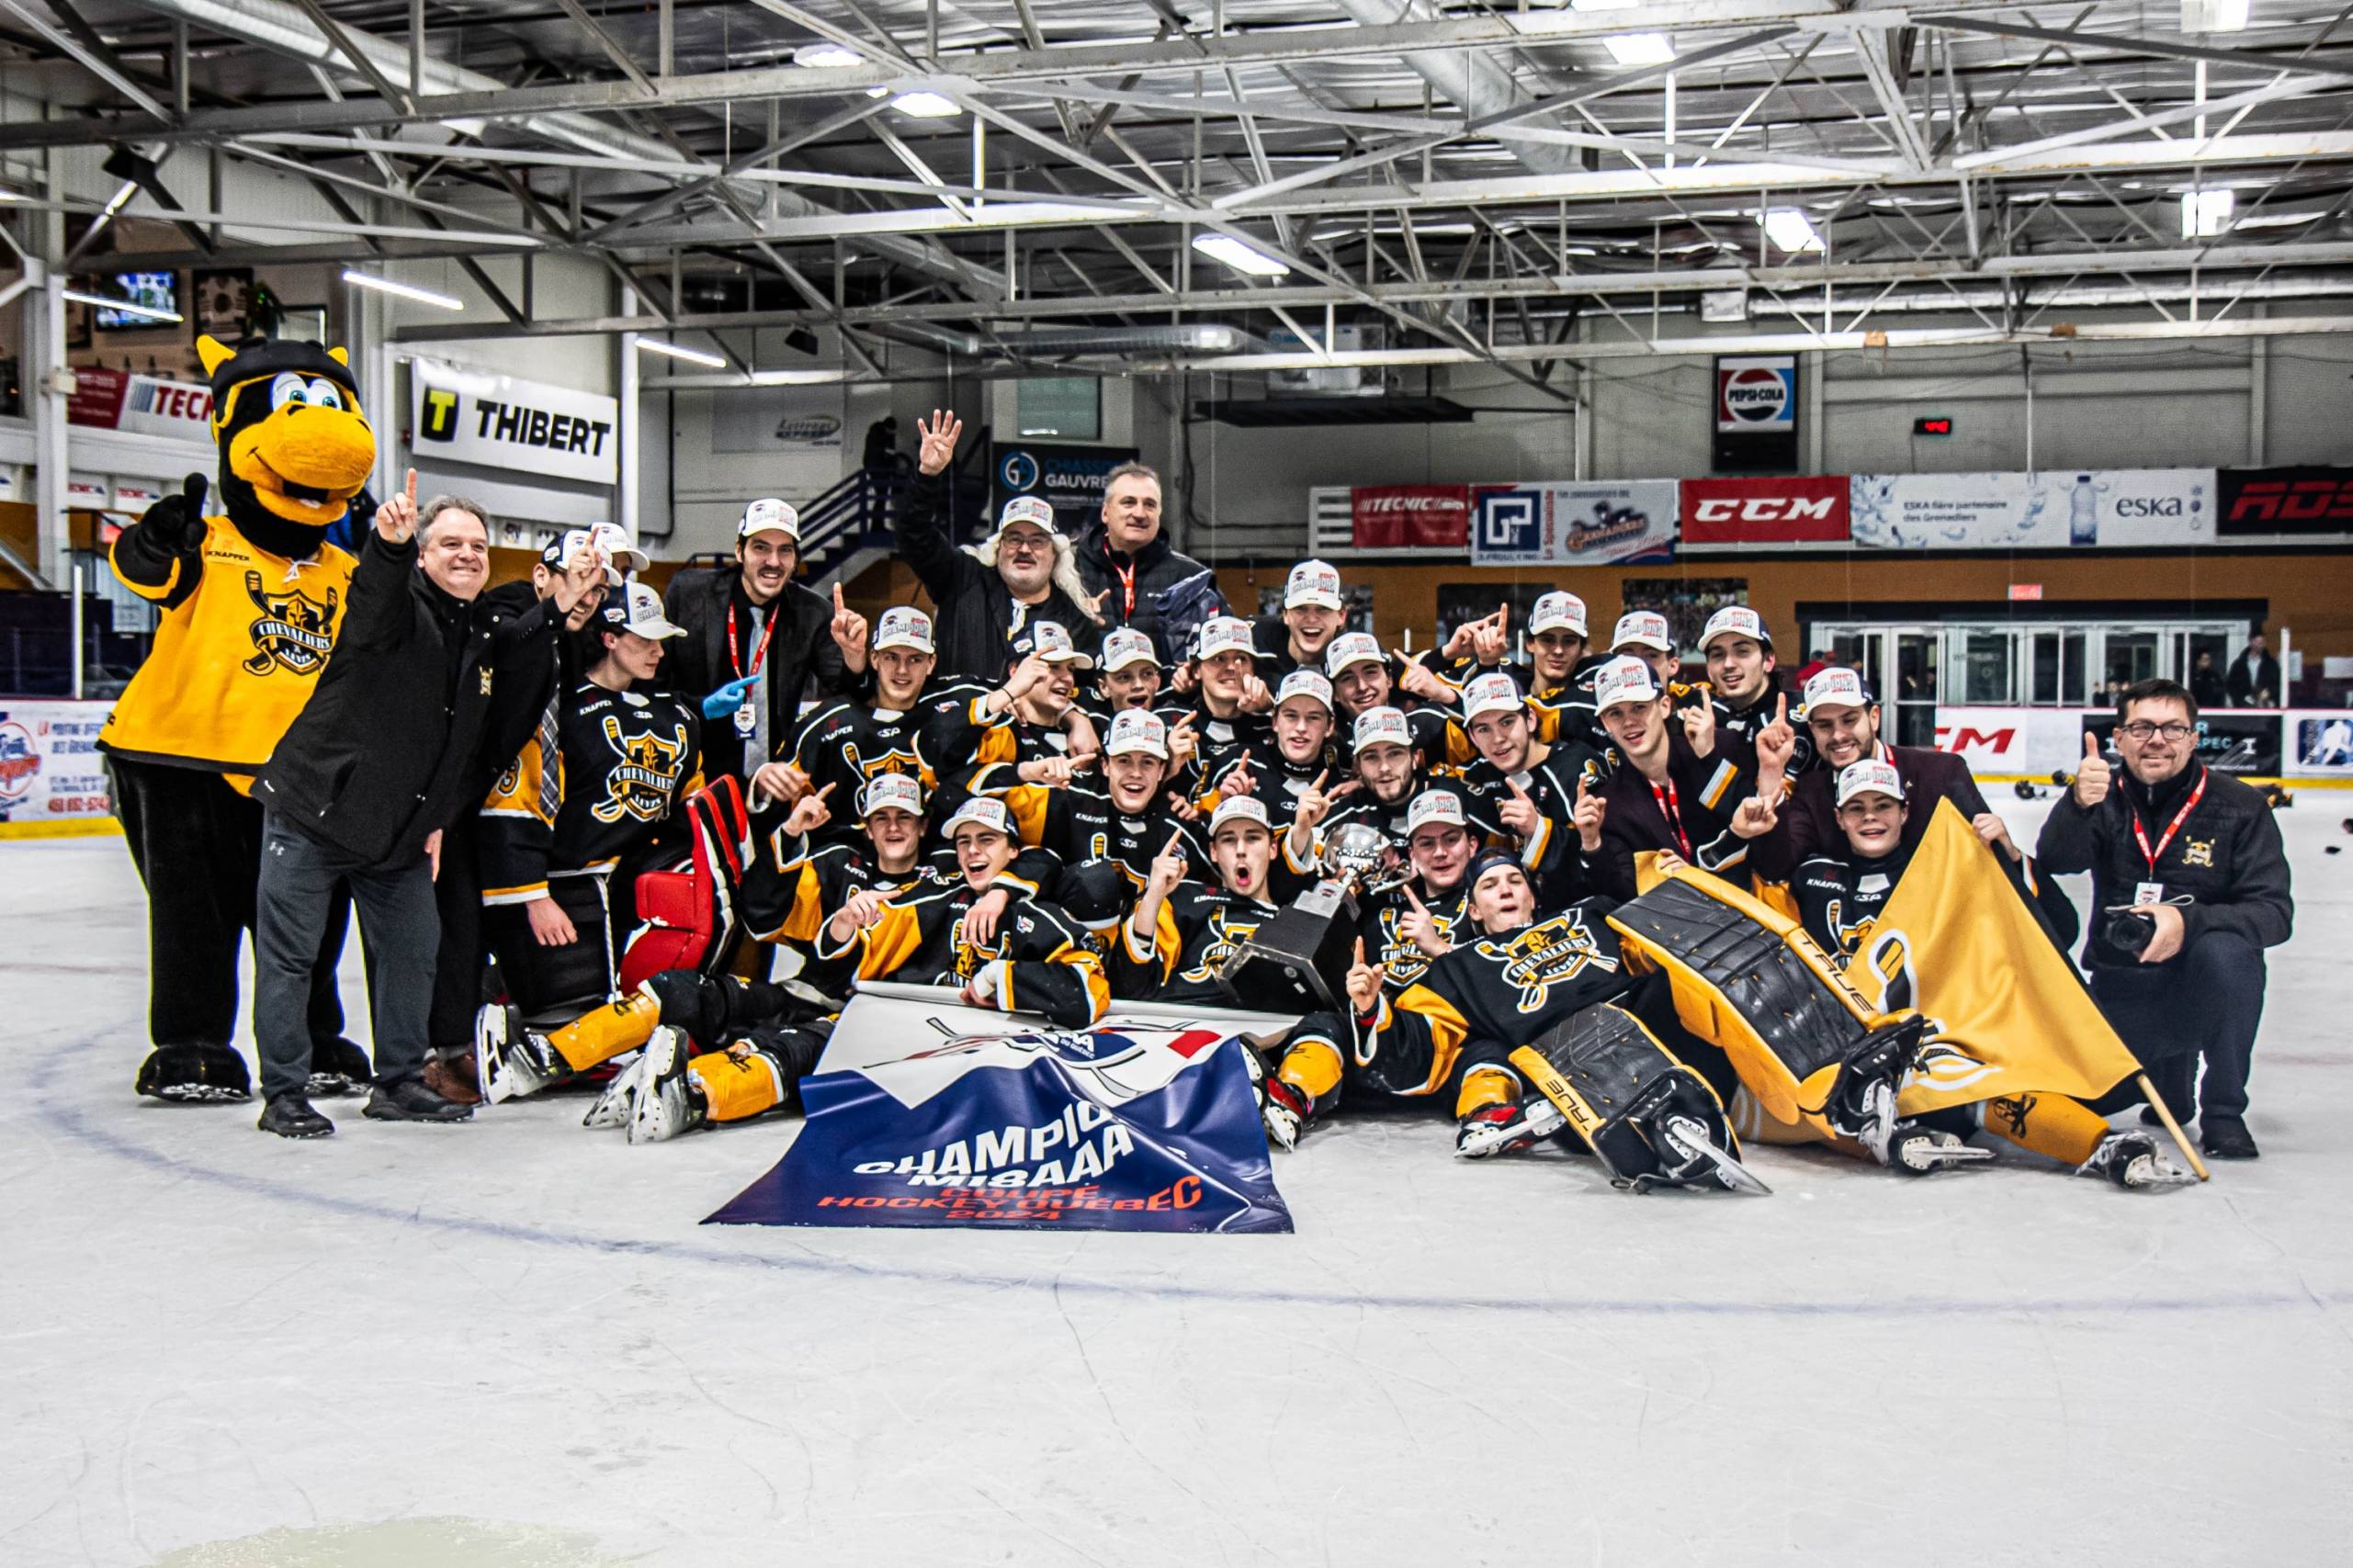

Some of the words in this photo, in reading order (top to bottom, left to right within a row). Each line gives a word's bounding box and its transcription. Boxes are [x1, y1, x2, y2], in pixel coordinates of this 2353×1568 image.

[476, 399, 611, 457] THIBERT
[1693, 497, 1836, 522] CCM
[1903, 502, 1929, 511] ESKA
[1955, 501, 2008, 511] partenaire
[2115, 496, 2182, 517] eska
[1903, 513, 1921, 522] des
[1922, 513, 1977, 523] Grenadiers
[258, 622, 332, 649] CHEVALIERS
[580, 700, 613, 716] KNAPPER
[1510, 937, 1589, 977] CHEVALIERS
[1801, 931, 1875, 1012] TRUE
[940, 1185, 1101, 1200] COUPE
[817, 1196, 1007, 1211] HOCKEY
[945, 1210, 1062, 1220] 2024
